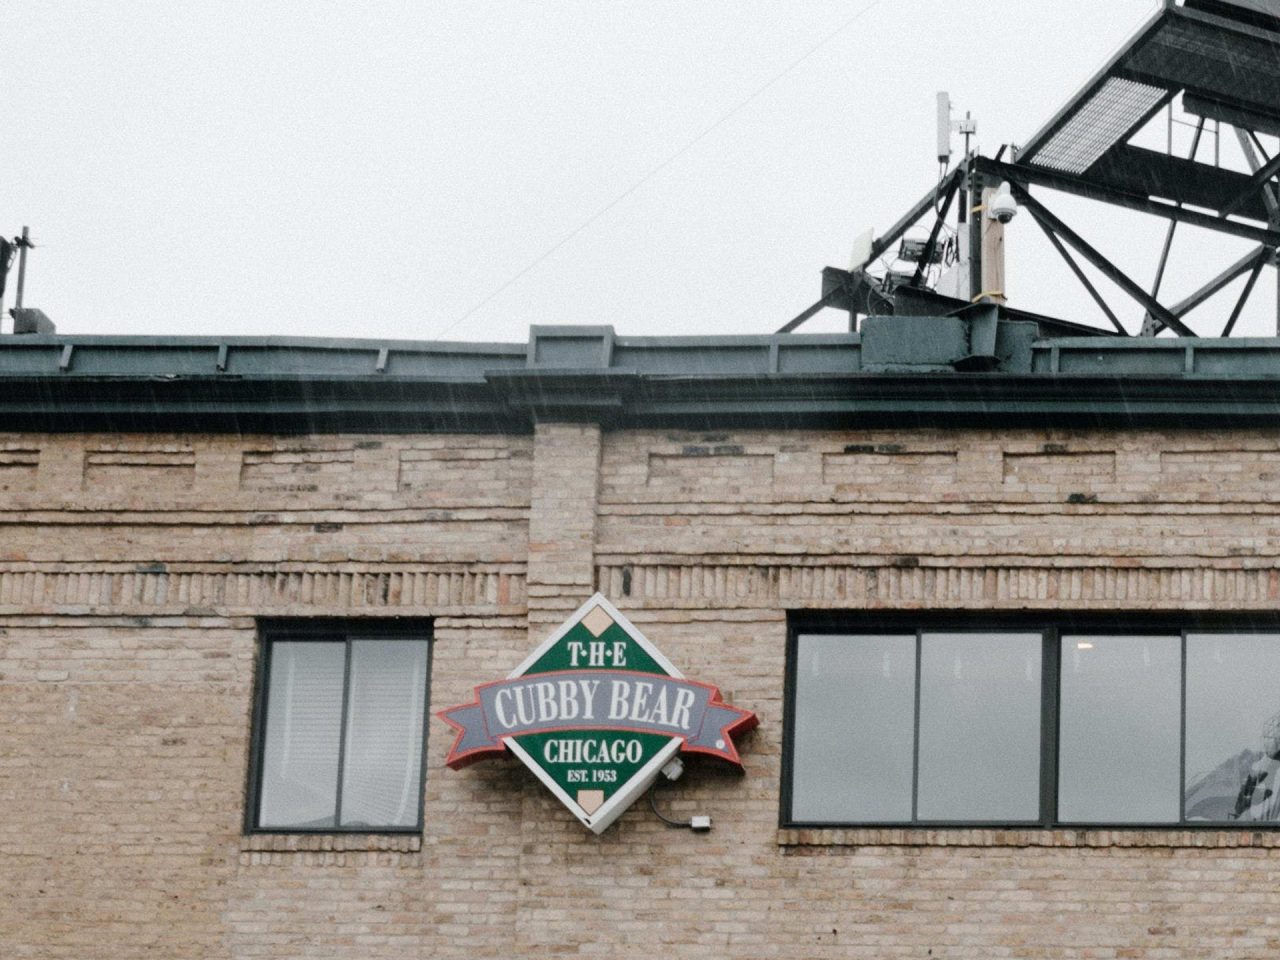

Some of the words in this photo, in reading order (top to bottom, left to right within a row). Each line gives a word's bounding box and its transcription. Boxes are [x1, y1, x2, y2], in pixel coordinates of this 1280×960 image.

[494, 679, 600, 729] CUBBY
[607, 679, 696, 730] BEAR
[543, 739, 643, 764] CHICAGO
[567, 769, 589, 782] EST.
[592, 769, 617, 782] 1953
